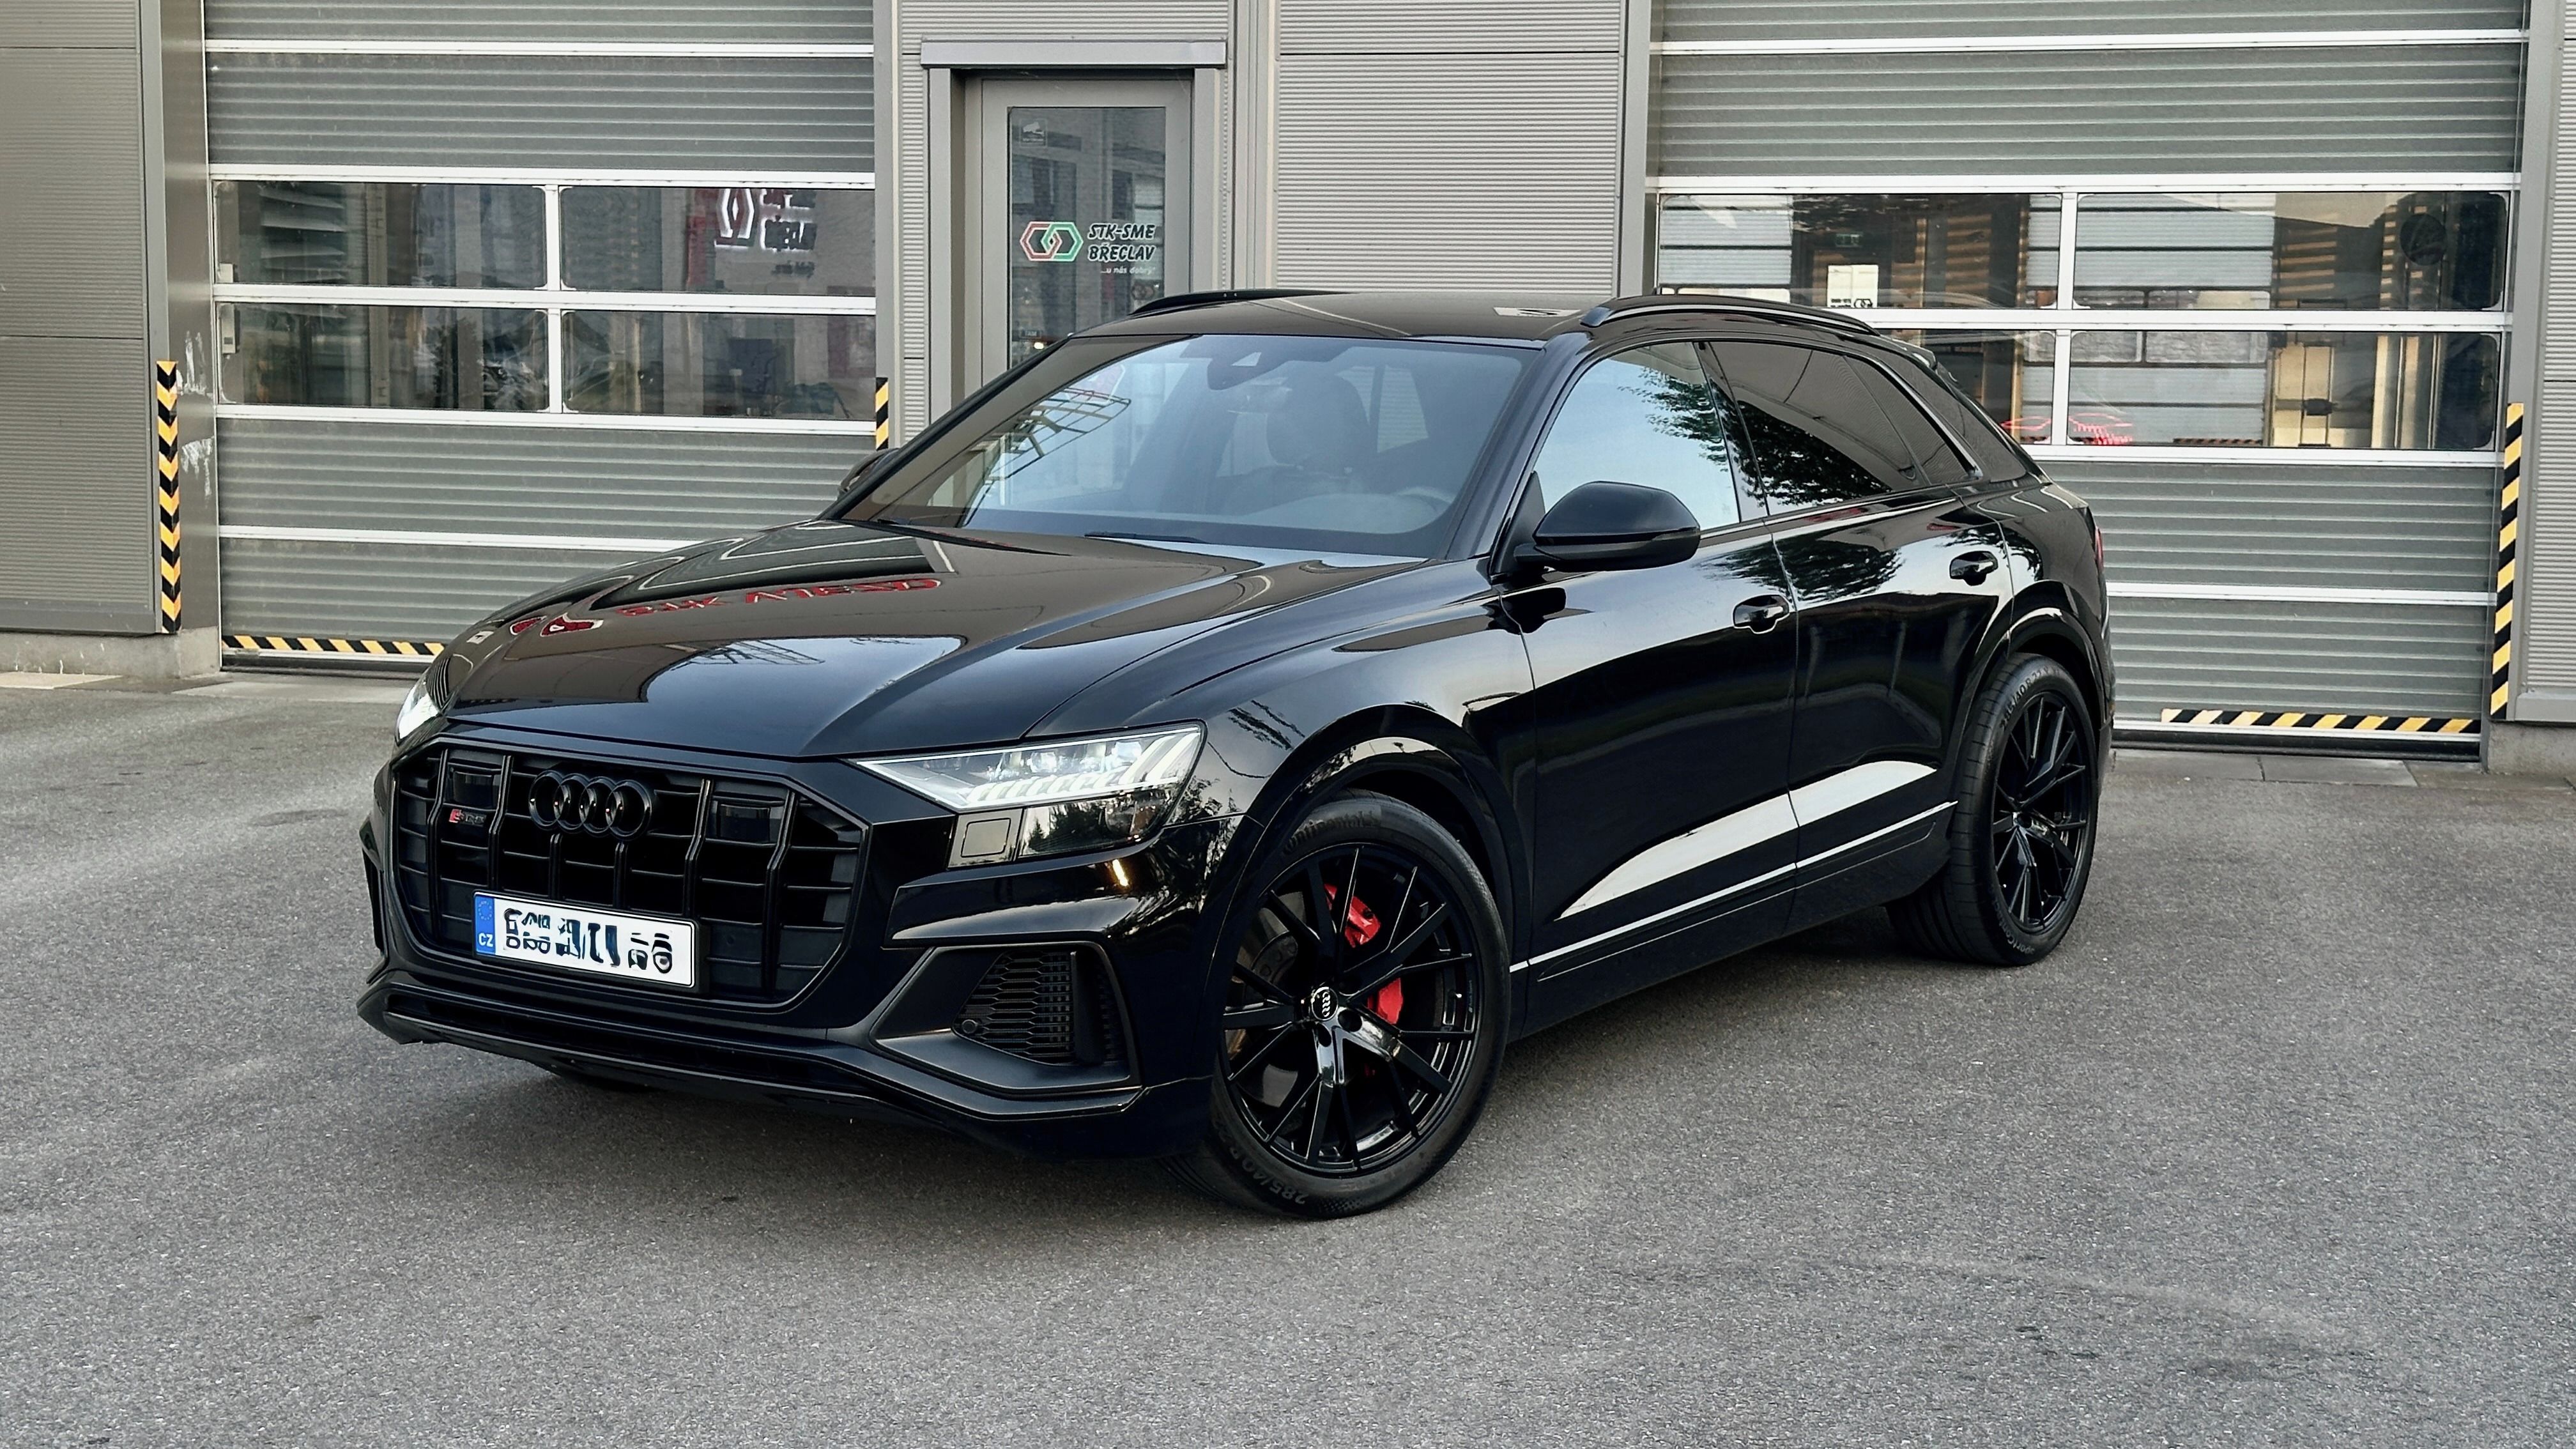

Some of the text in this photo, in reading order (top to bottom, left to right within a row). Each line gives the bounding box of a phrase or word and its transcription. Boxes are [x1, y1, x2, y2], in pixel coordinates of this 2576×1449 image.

[1087, 223, 1155, 240] STK-SME
[1087, 242, 1156, 263] BŘECLAV
[479, 932, 493, 947] CZ
[1242, 1156, 1310, 1204] 285/40
